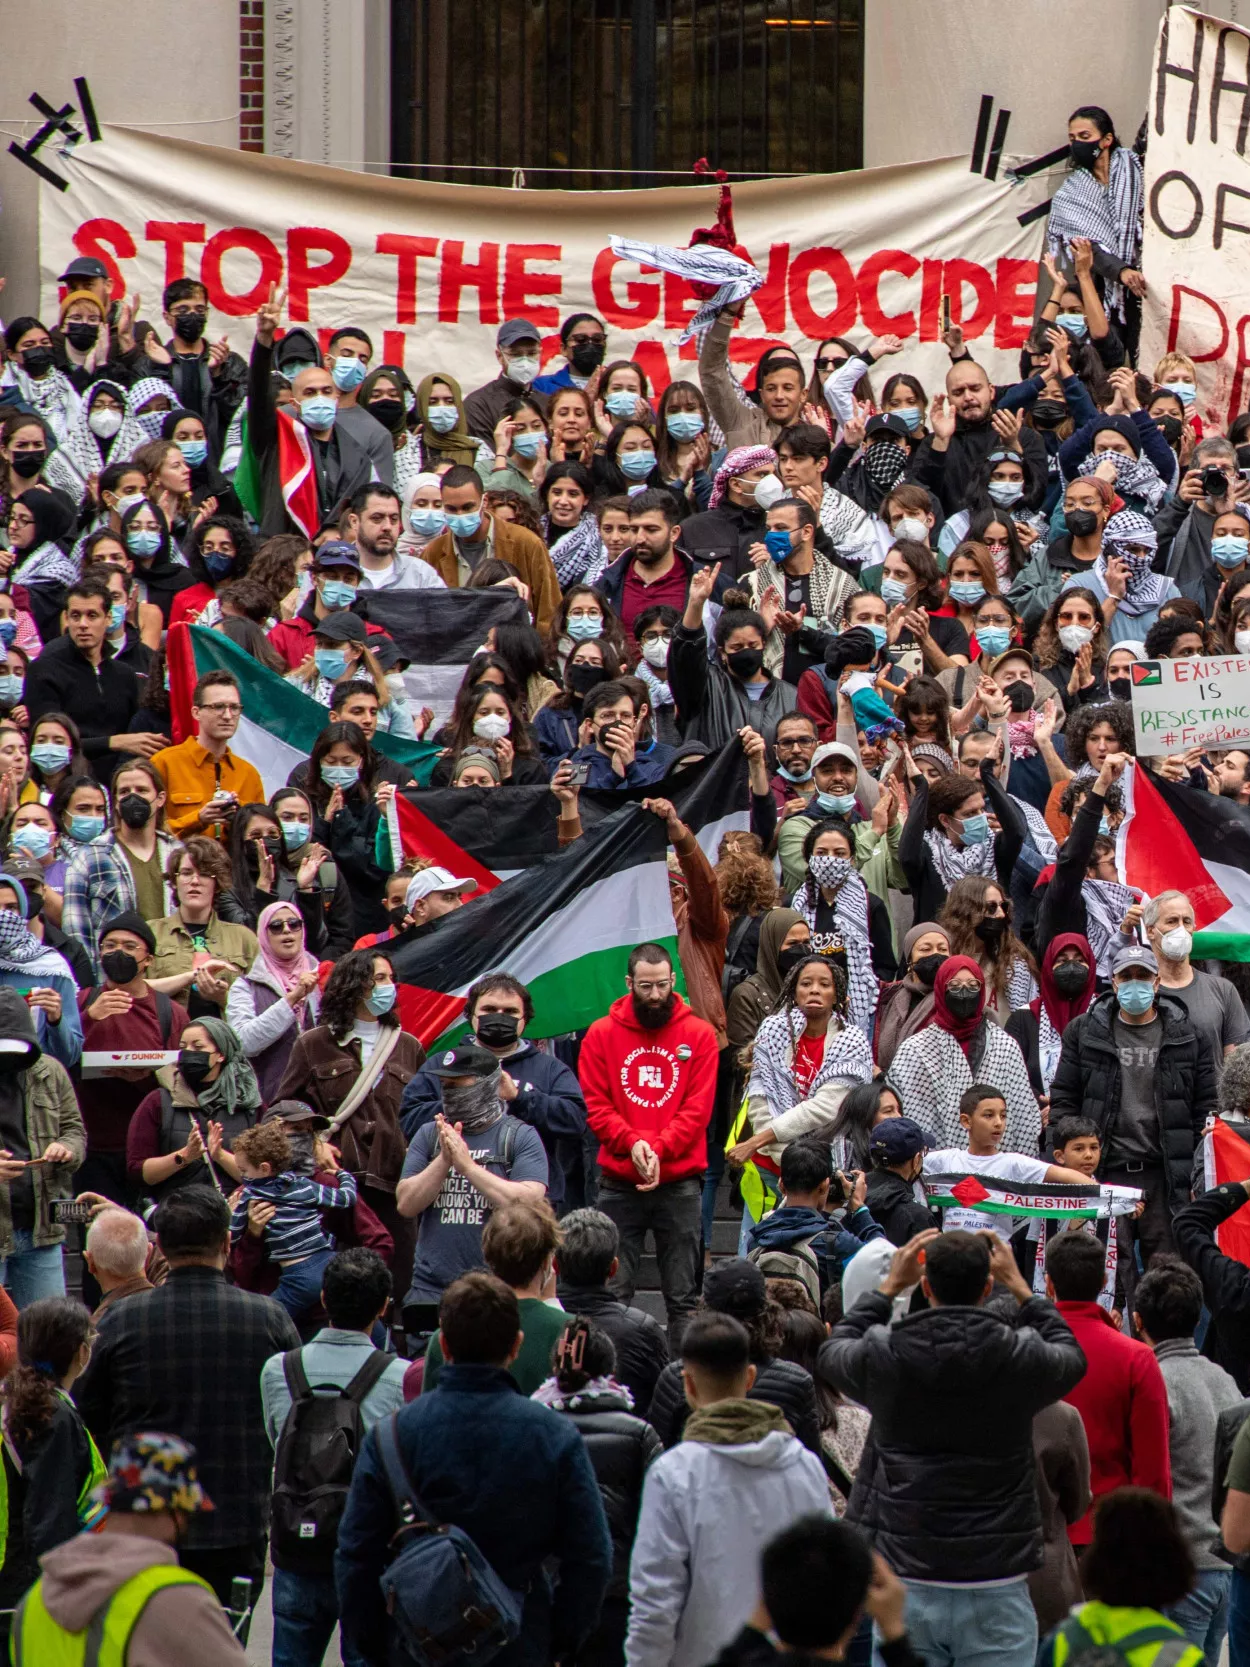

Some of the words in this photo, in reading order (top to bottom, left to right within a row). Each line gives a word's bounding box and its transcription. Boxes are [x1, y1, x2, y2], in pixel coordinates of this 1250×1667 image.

[59, 218, 352, 322] STOP
[376, 233, 562, 327] THE
[1199, 683, 1222, 700] IS
[621, 1067, 629, 1086] FOR
[656, 1062, 679, 1108] LIBERATION
[623, 1087, 649, 1108] PARTY
[441, 1179, 469, 1193] NCLE
[433, 1194, 471, 1209] KNOWS
[1004, 1193, 1087, 1209] PALESTINE
[440, 1209, 465, 1224] CAN
[467, 1210, 484, 1224] BE
